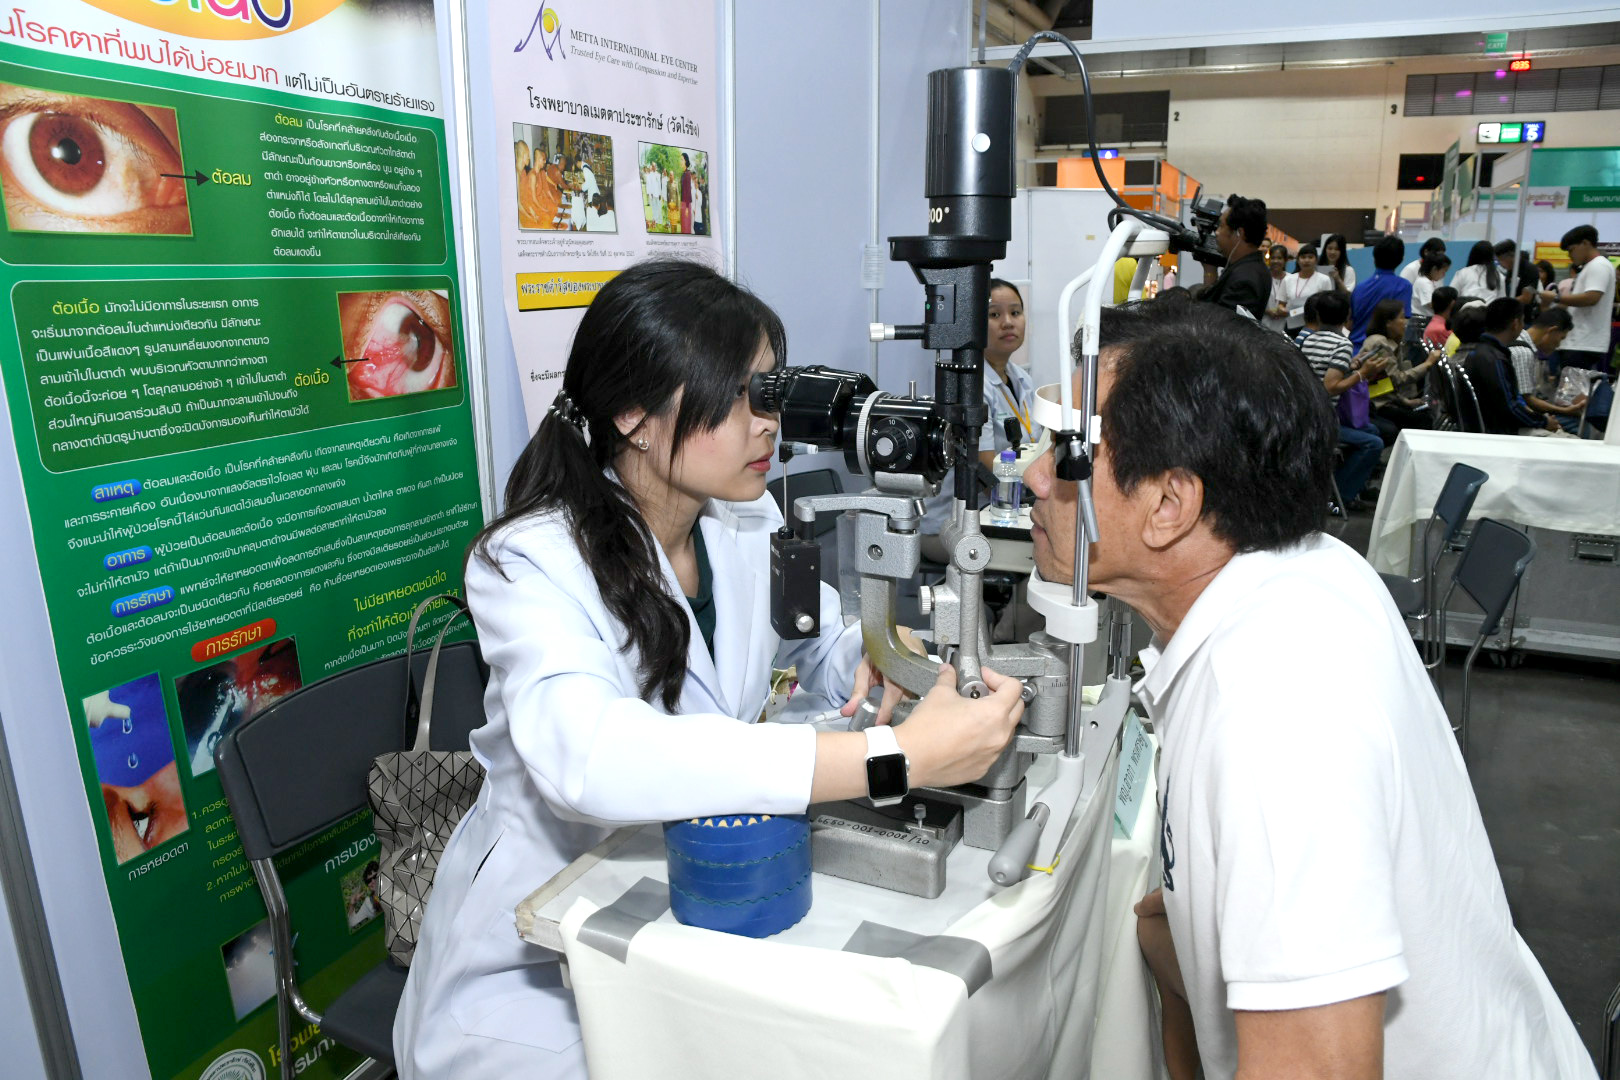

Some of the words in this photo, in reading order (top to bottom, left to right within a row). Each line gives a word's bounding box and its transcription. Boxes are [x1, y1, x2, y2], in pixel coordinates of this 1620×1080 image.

[570, 29, 599, 46] METTA
[600, 37, 659, 63] INTERNATIONAL
[661, 52, 675, 66] EYE
[675, 58, 698, 73] CENTER
[571, 45, 594, 59] Trusted
[594, 51, 606, 65] Eye
[607, 54, 620, 65] Care
[621, 57, 634, 69] with
[634, 61, 667, 77] Compassion
[667, 69, 678, 79] and
[678, 72, 698, 86] Expertise
[285, 73, 435, 112] แต่ไม่เป็นอันตรายร้ายแรง
[275, 112, 303, 128] ต้อลม
[527, 86, 663, 131] โรงพยาบาลเมตตาประชารักษ์
[666, 115, 700, 138] (วัดไร่ขิง)
[1174, 111, 1180, 121] 2
[1390, 104, 1398, 115] 3
[1527, 127, 1538, 141] 5
[211, 169, 252, 186] ต้อลม
[264, 171, 283, 181] ตาดำ
[266, 189, 311, 203] ตำแหน่งก็ได้
[268, 208, 296, 219] ต้อเนื้อ
[271, 227, 305, 238] อักเสบได้
[273, 246, 321, 257] ต้อลมแดงขึ้น
[52, 298, 100, 315] ต้อเนื้อ
[104, 298, 229, 313] มักจะไม่มีอาการในระยะแรก
[232, 298, 259, 308] อาการ
[31, 318, 218, 339] จะเริ่มมาจากต้อลมในตำแหน่งเดียวกัน
[221, 317, 261, 328] มีลักษณะ
[144, 336, 270, 358] รูปสามเหลี่ยมงอกจากตาขาว
[40, 366, 126, 385] ลามเข้าไปในตาดำ
[130, 355, 268, 376] พบบริเวณหัวตามากกว่าหางตา
[294, 367, 330, 388] ต้อเนื้อ
[131, 387, 140, 399] ๆ
[143, 377, 223, 398] โตลุกลามอย่างช้า
[227, 378, 234, 388] ๆ
[236, 370, 287, 387] เข้าไปในตาดำ
[48, 401, 181, 430] ส่วนใหญ่กินเวลาร่วมสิบปี
[185, 388, 298, 412] ถ้าเป็นมากจะลามเข้าไปจนถึง
[95, 482, 134, 500] สาเหตุ
[143, 466, 221, 490] ต้อลมและต้อเนื้อ
[224, 448, 312, 474] เป็นโรคที่คล้ายคลึงกัน
[315, 436, 391, 458] เกิดจากสาเหตุเดียวกัน
[64, 501, 156, 528] และการระคายเคือง
[160, 471, 303, 510] อันเนื่องมาจากแสงอัลตราไวโอเลต
[321, 461, 343, 473] และลม
[107, 548, 146, 567] อาการ
[154, 517, 273, 557] ผู้ป่วยเป็นต้อลมและต้อเนื้อ
[396, 484, 416, 496] ตาแดง
[77, 570, 150, 598] จะไม่ทำให้ตามัว
[309, 582, 321, 594] คือ
[115, 589, 172, 614] การรักษา
[86, 586, 250, 645] ต้อเนื้อและต้อลมจะเป็นชนิดเดียวกัน
[206, 626, 262, 657] การรักษา
[324, 640, 385, 670] หากต้อเนื้อเป็นมาก
[128, 842, 190, 881] การหยอดตา
[325, 833, 379, 873] การป้อง
